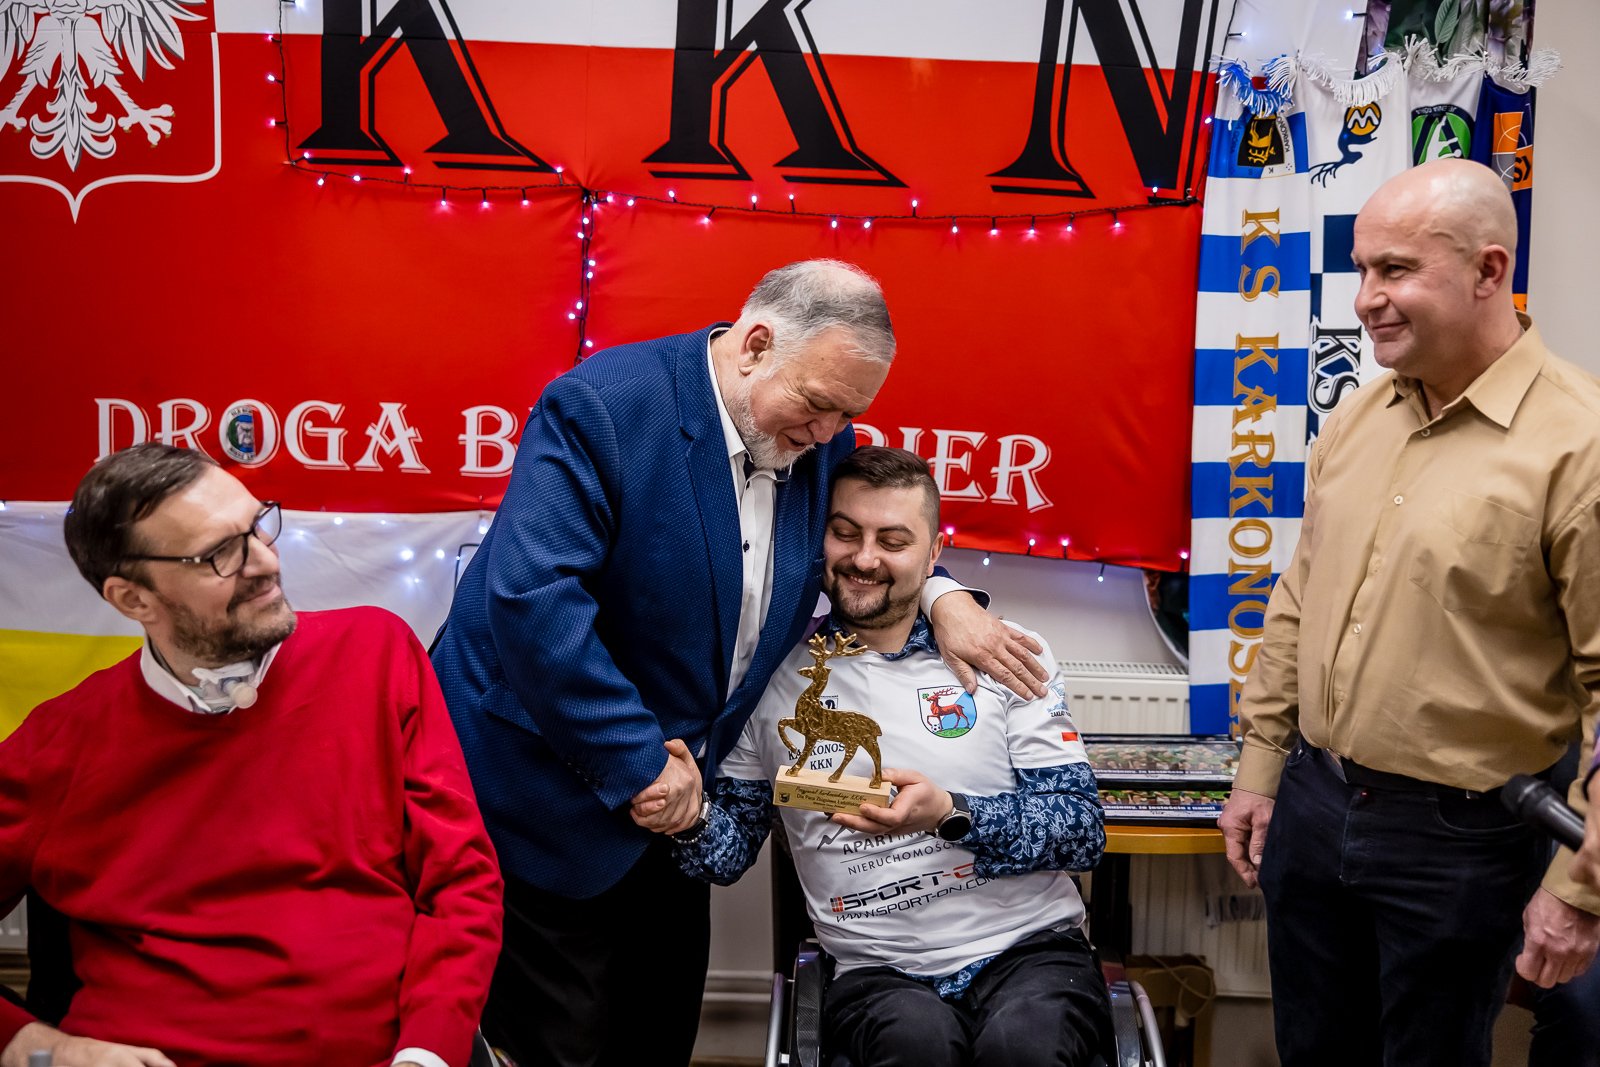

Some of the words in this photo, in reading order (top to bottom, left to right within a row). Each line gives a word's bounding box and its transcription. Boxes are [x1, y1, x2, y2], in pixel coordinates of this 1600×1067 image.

[1237, 206, 1281, 303] KS
[93, 398, 431, 474] DROGA
[1227, 332, 1280, 739] KARKONOS
[788, 743, 846, 761] KAKONOS
[810, 758, 833, 770] KKN
[842, 862, 975, 911] SPORT-O
